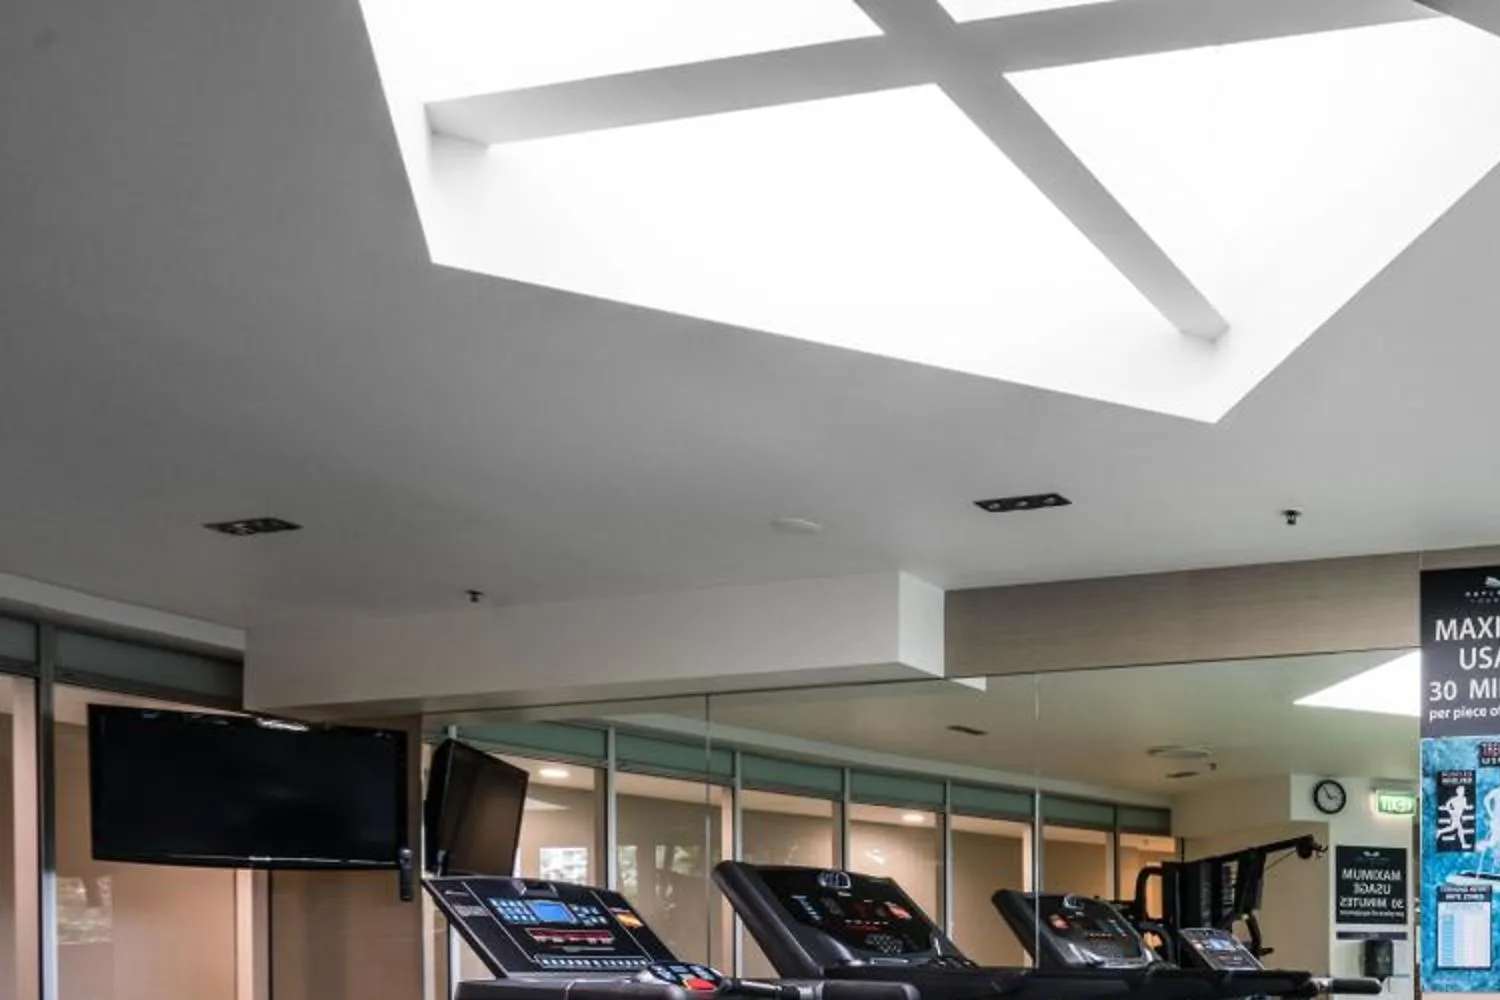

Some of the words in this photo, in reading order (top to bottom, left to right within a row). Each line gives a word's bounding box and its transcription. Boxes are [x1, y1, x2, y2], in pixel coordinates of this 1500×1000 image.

[1429, 680, 1457, 701] 30
[1429, 707, 1451, 723] per
[1453, 705, 1487, 720] piece
